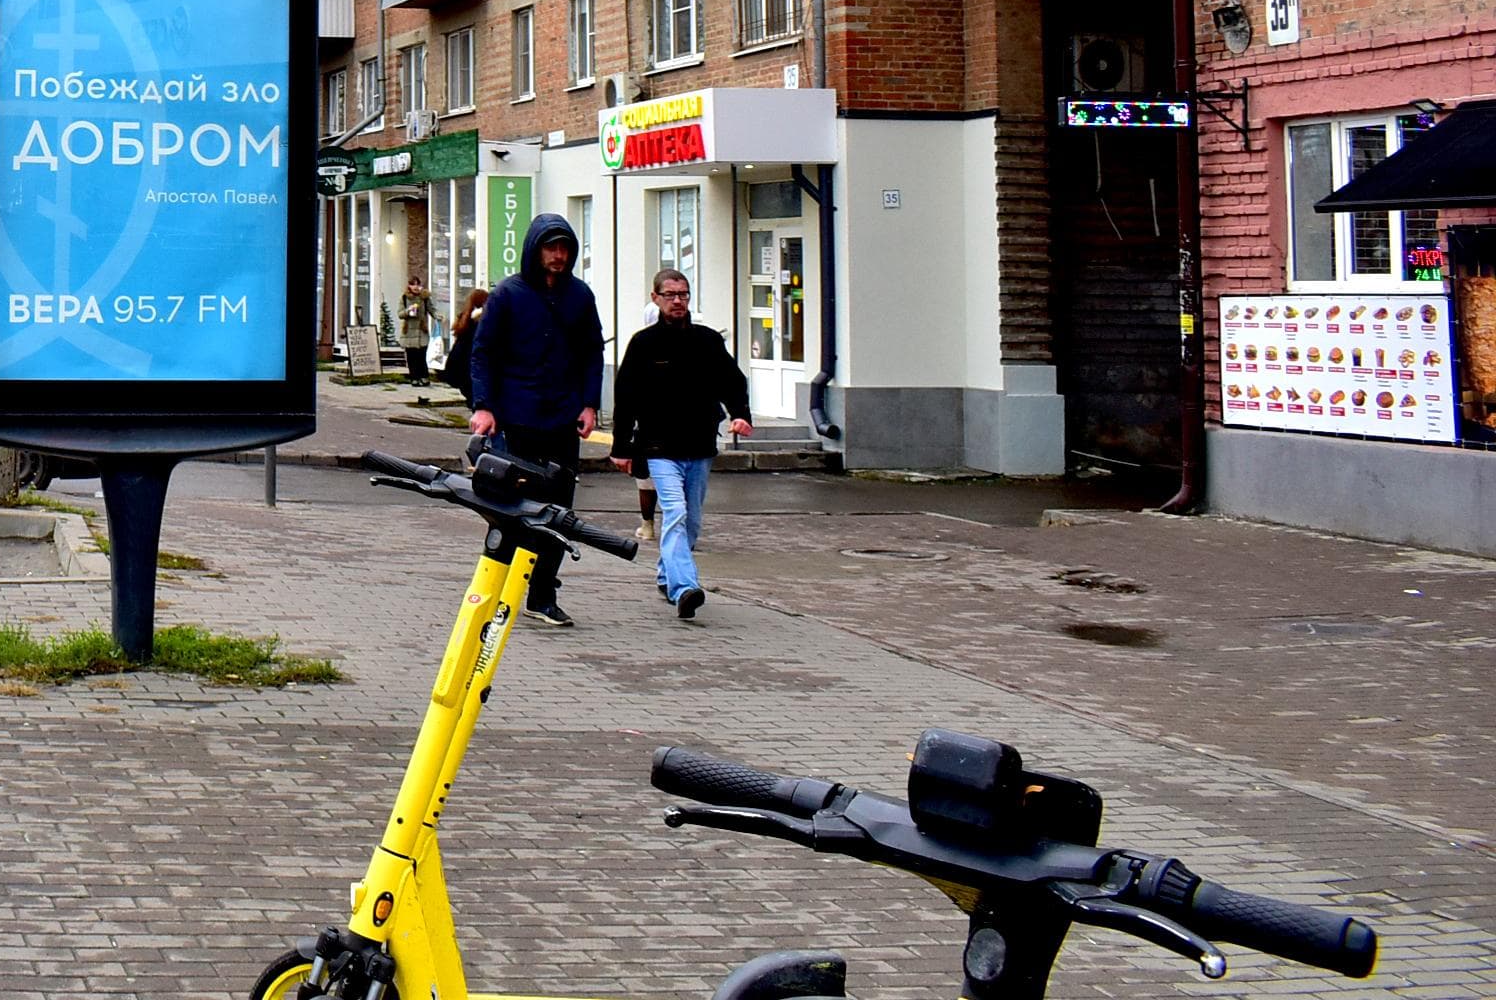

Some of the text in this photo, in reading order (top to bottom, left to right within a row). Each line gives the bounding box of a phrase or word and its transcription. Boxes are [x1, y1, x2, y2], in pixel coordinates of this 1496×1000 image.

[14, 69, 280, 104] Побеждай зло
[622, 96, 703, 129] СОЦИАЛЬНАЯ
[12, 119, 281, 171] ДОБРОМ
[624, 124, 706, 169] АПТЕКА
[145, 189, 278, 205] Апостол Павел
[885, 193, 898, 204] 35
[8, 294, 248, 324] ВЕРА 95.7 FM
